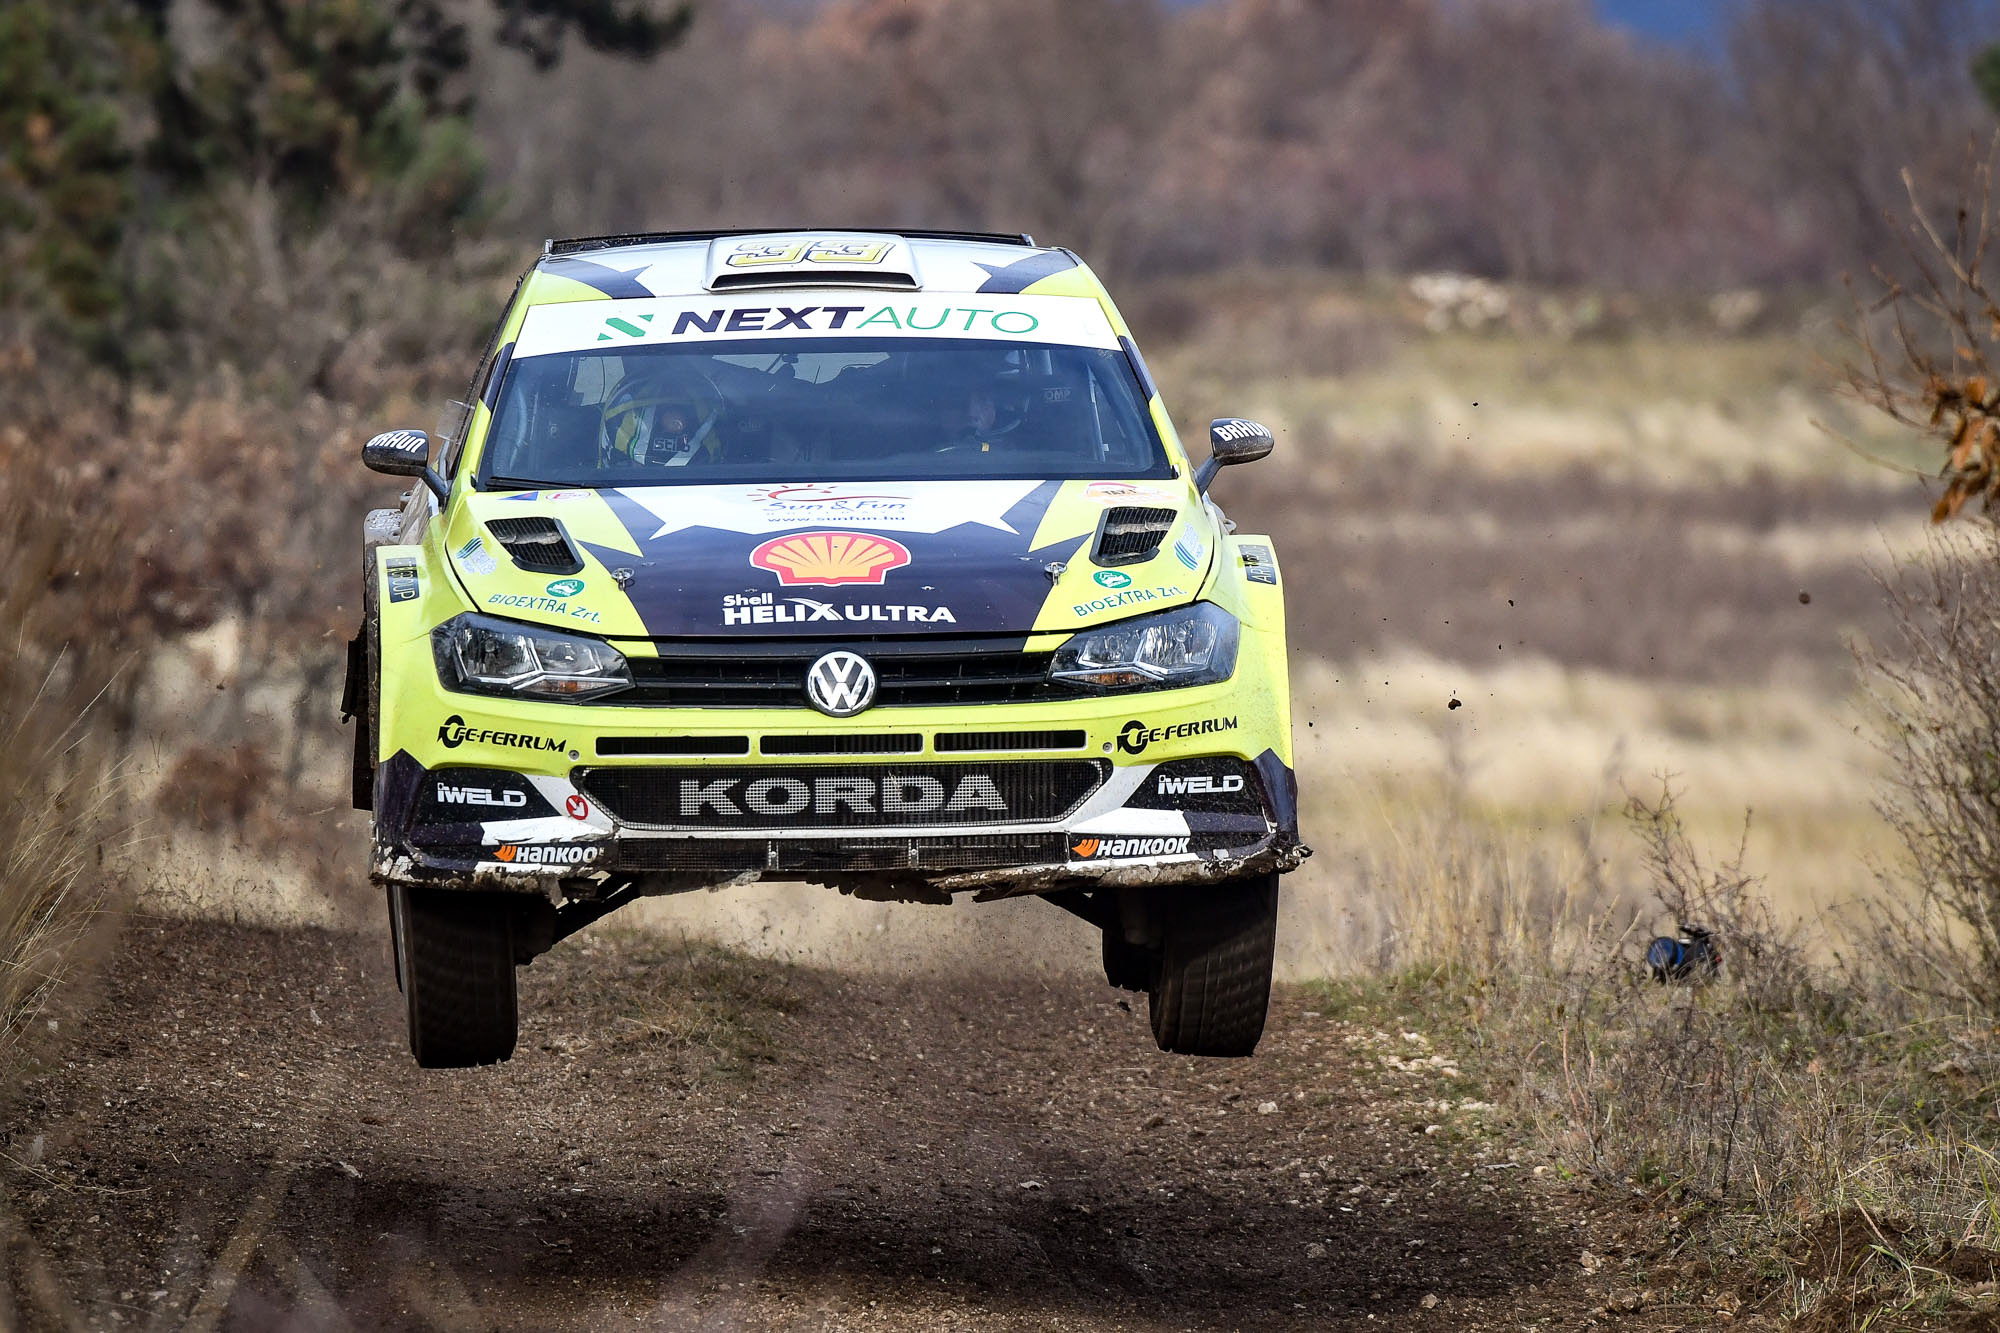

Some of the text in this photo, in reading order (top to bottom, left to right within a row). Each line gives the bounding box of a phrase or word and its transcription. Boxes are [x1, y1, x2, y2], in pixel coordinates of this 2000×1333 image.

[672, 306, 1039, 334] NEXTAUTO
[488, 594, 567, 614] BIOEXTRA
[722, 599, 957, 625] HELIX ULTRA
[723, 593, 773, 607] Shell
[1073, 591, 1155, 616] BIOEXTRA
[680, 774, 1008, 815] KORDA
